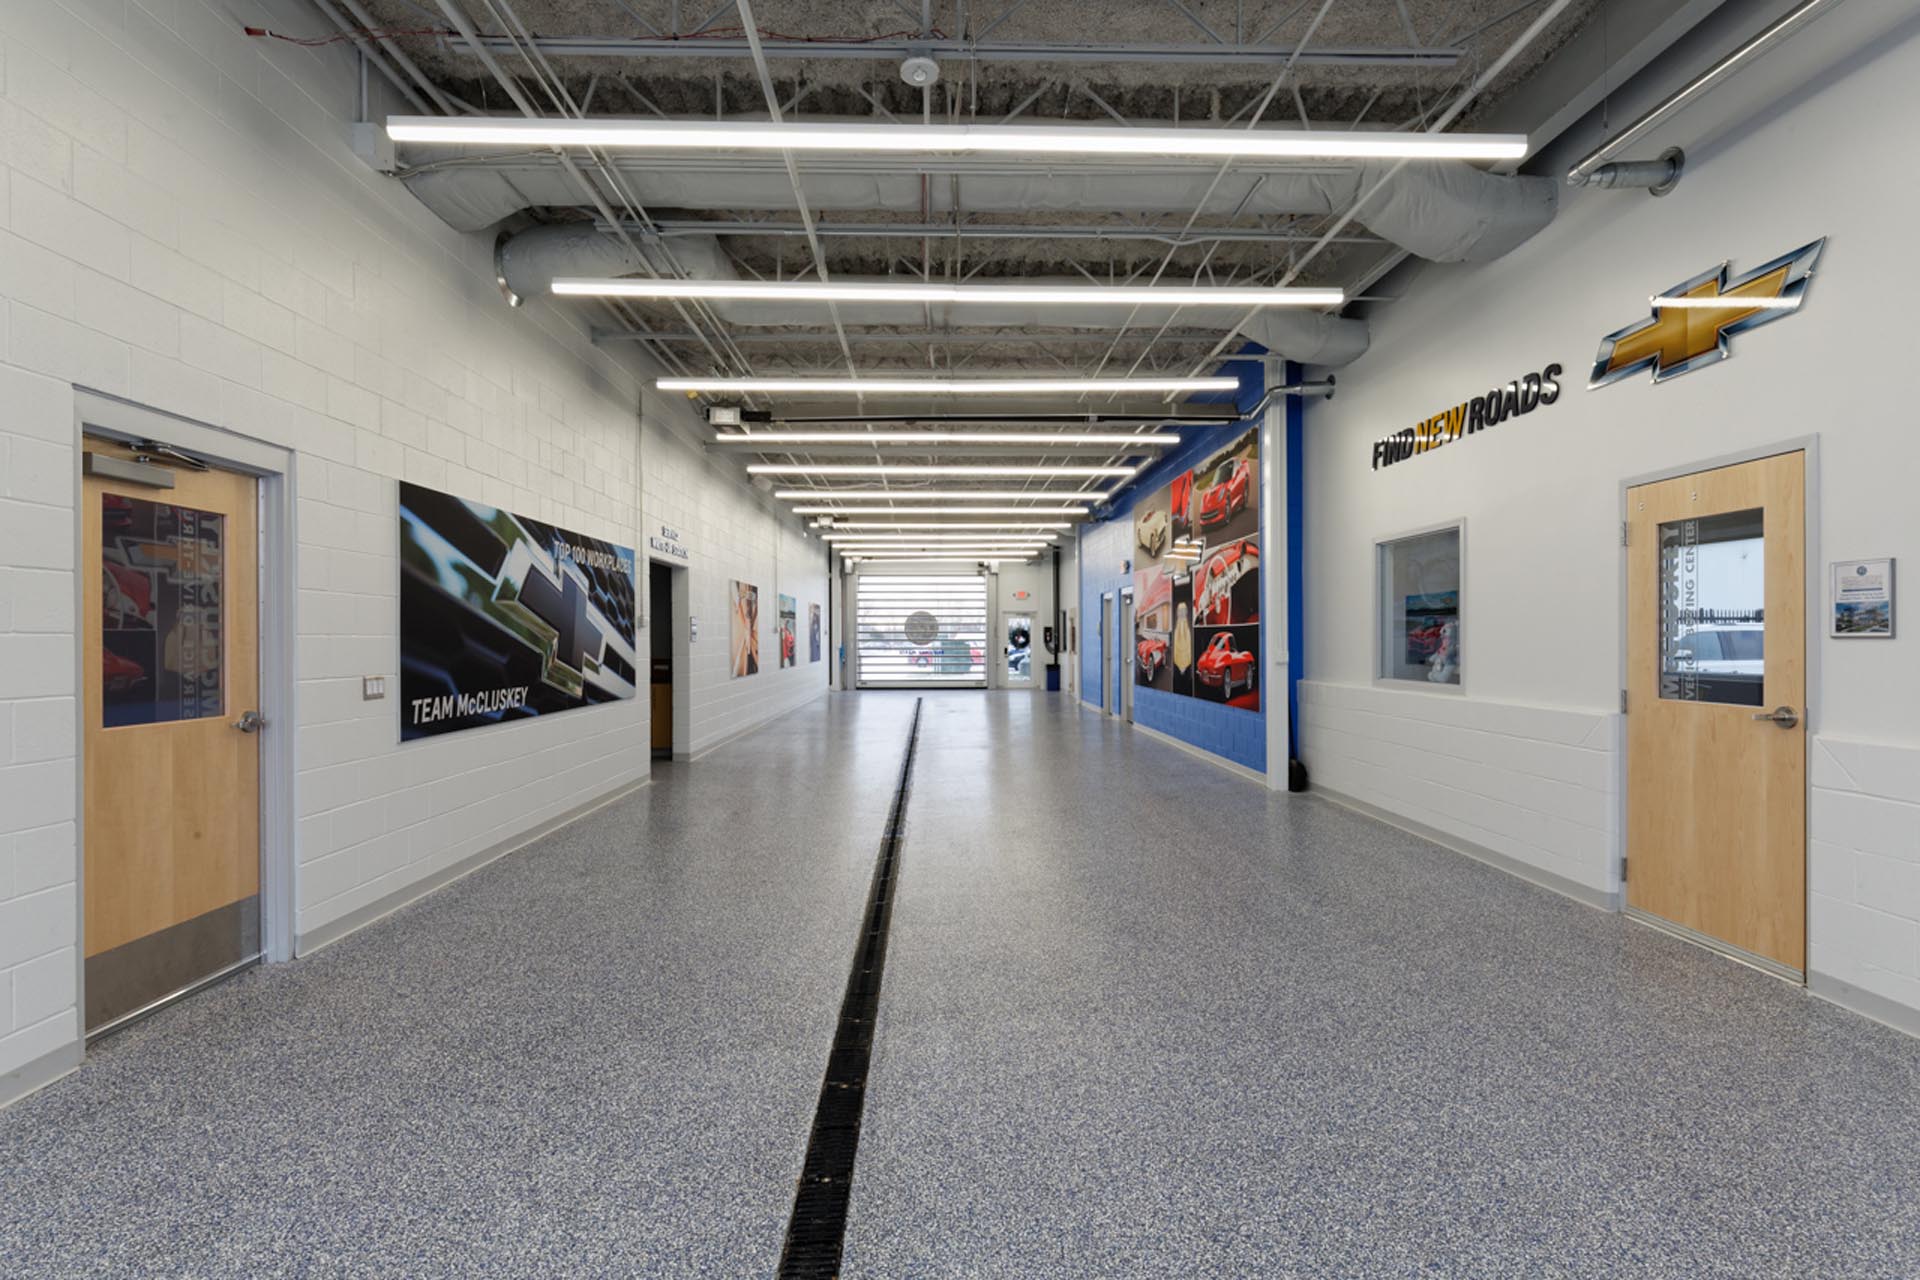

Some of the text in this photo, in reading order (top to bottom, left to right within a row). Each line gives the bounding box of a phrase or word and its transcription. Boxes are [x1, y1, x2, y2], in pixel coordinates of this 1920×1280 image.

[1371, 363, 1562, 471] FIND NEW ROADS
[554, 541, 571, 561] TOP
[572, 545, 586, 565] 100
[586, 548, 632, 574] WORKPLACES
[1684, 520, 1695, 573] CENTER
[412, 686, 529, 724] TEAM McCLUSKEY
